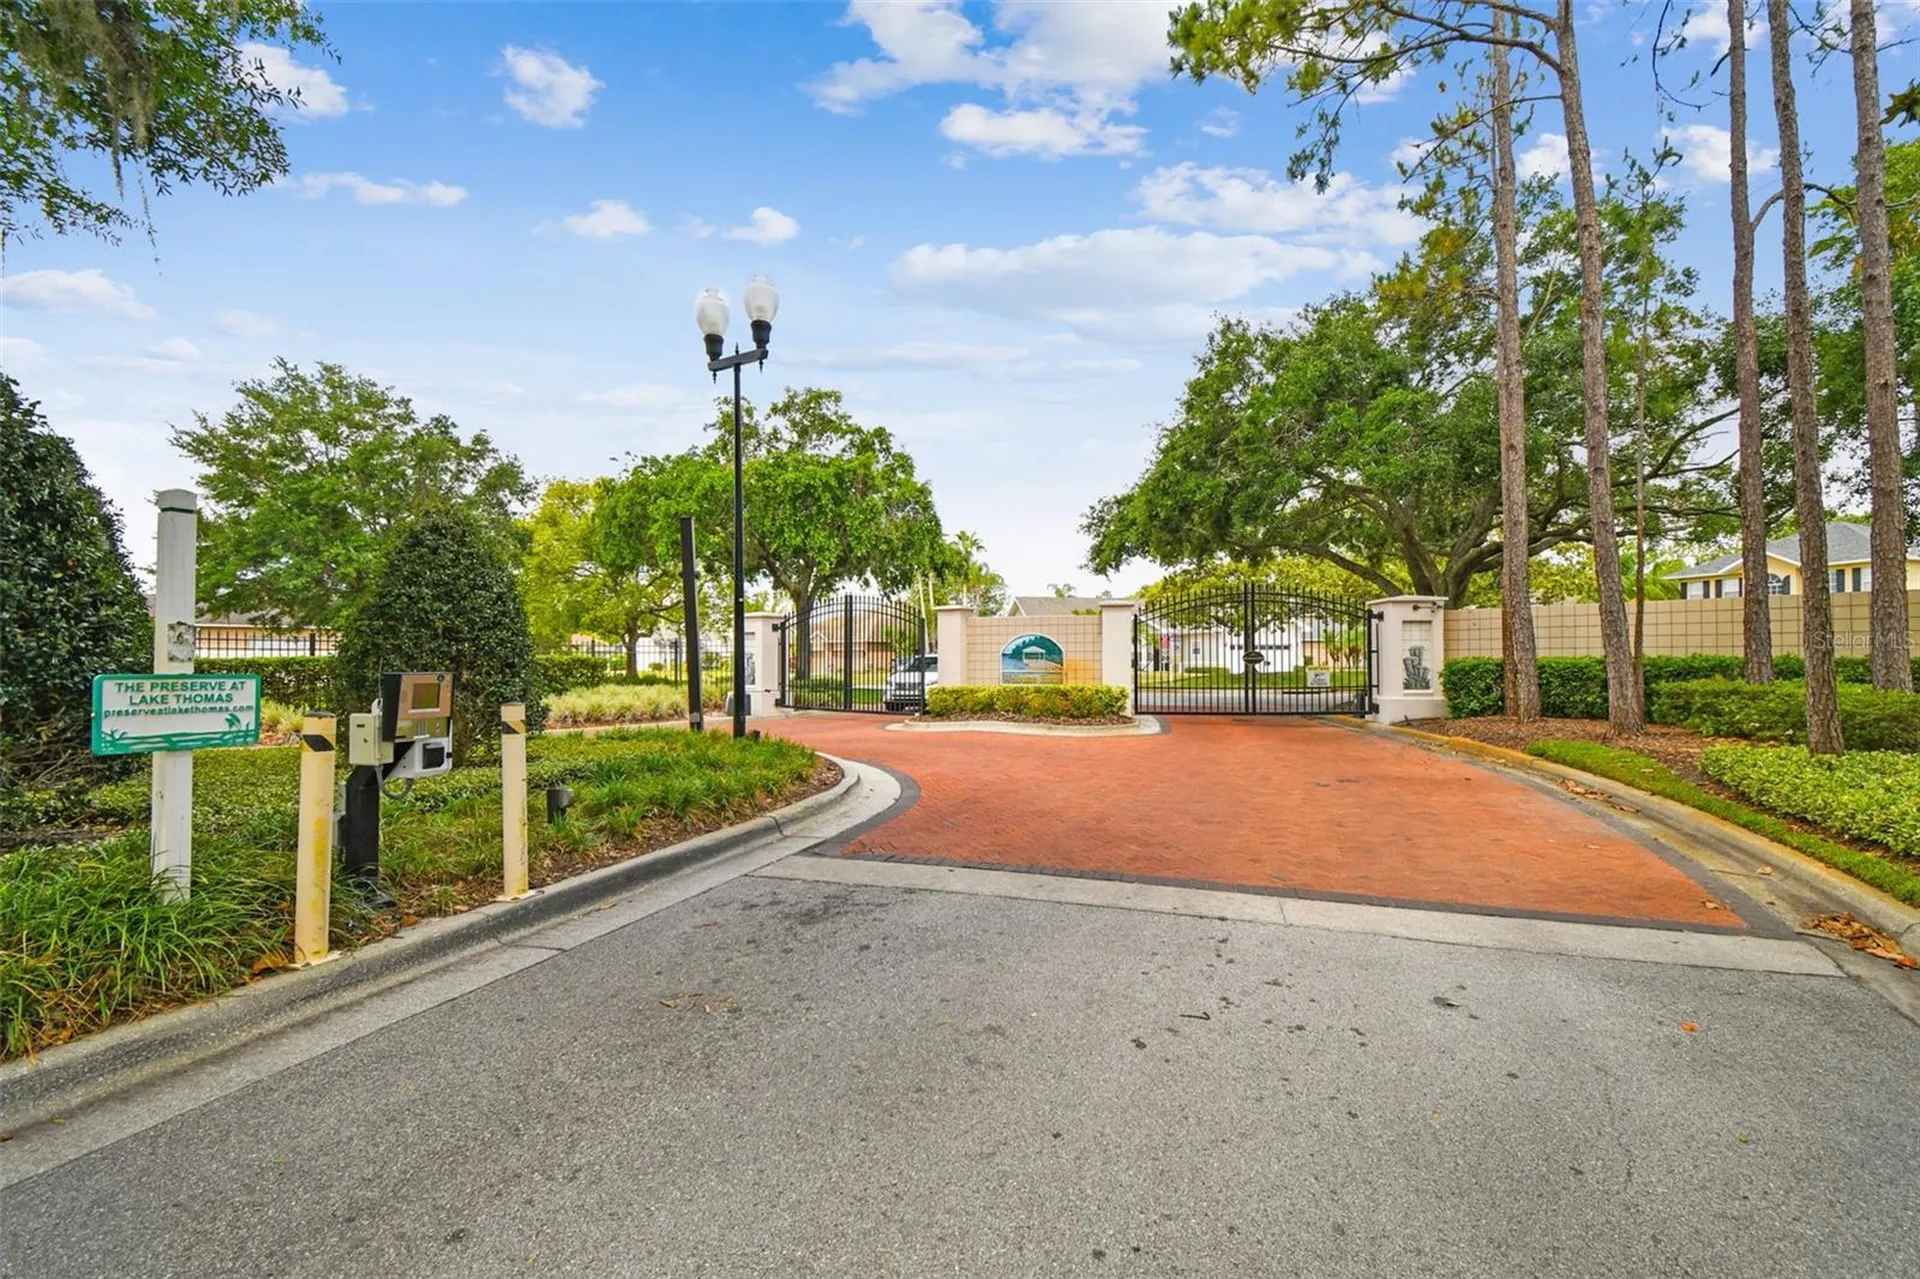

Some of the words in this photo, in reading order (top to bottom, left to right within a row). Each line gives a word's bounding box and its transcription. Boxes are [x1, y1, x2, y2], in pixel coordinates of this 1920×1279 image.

[115, 682, 145, 693] THE
[151, 681, 226, 692] PRESERVE
[229, 681, 246, 691] AT
[129, 694, 169, 705] LAKE
[174, 693, 233, 704] THOMAS
[104, 705, 254, 718] preserveatlakethomas.com
